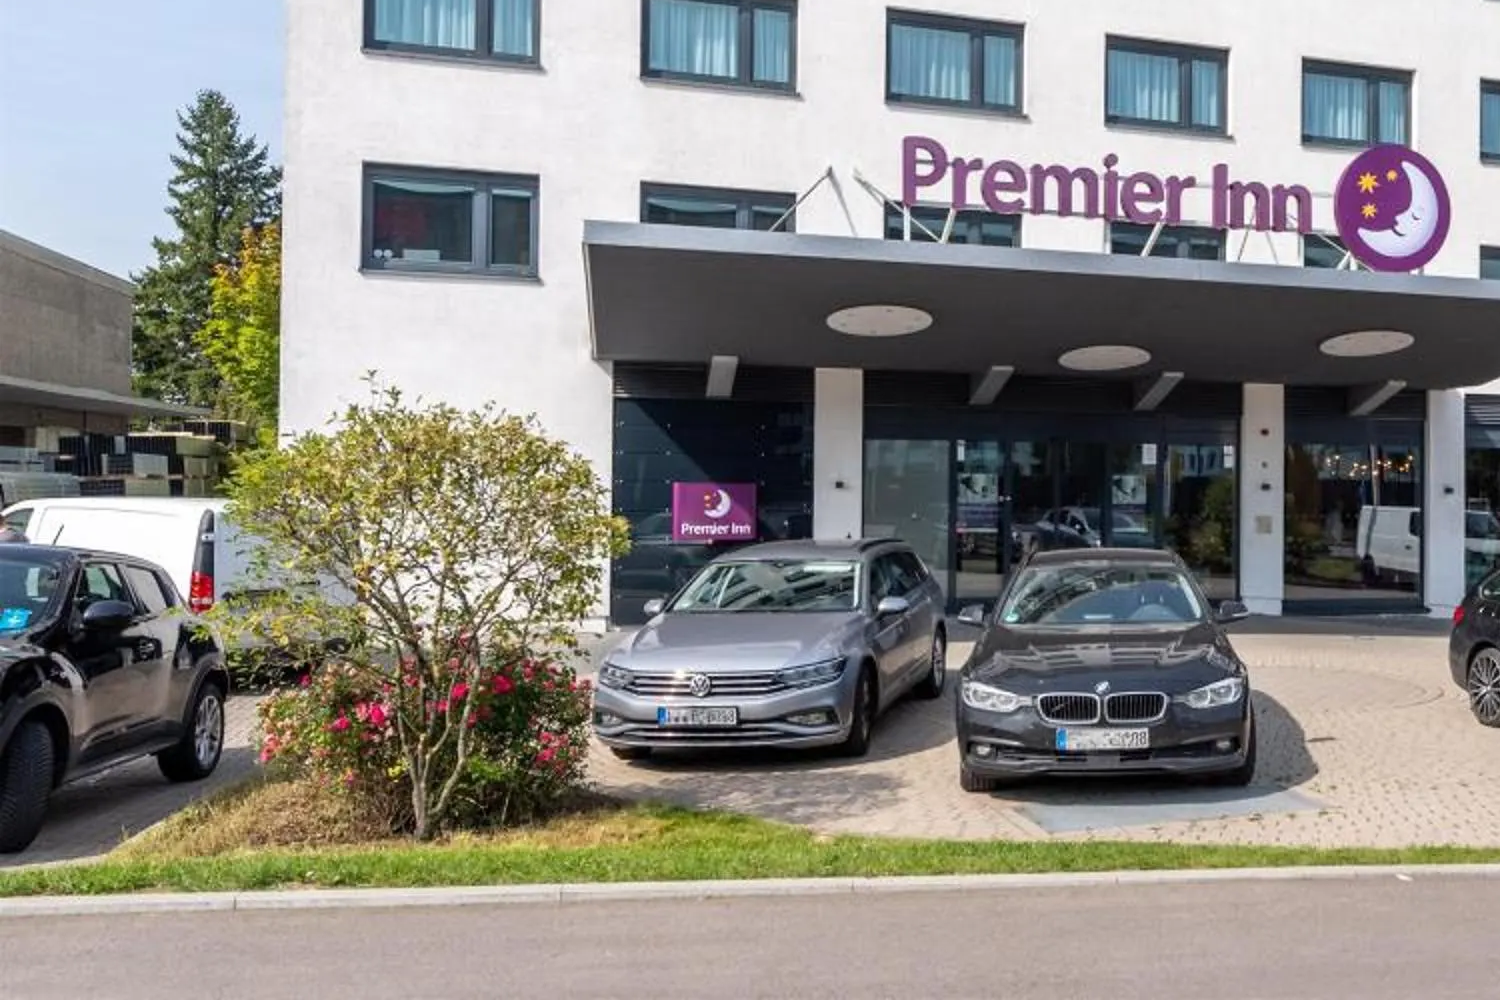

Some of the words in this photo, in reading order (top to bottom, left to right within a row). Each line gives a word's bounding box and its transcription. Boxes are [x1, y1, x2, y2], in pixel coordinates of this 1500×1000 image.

[902, 135, 1196, 226] Premier
[1212, 163, 1313, 233] Inn
[681, 522, 729, 535] Premier
[731, 522, 751, 535] Inn
